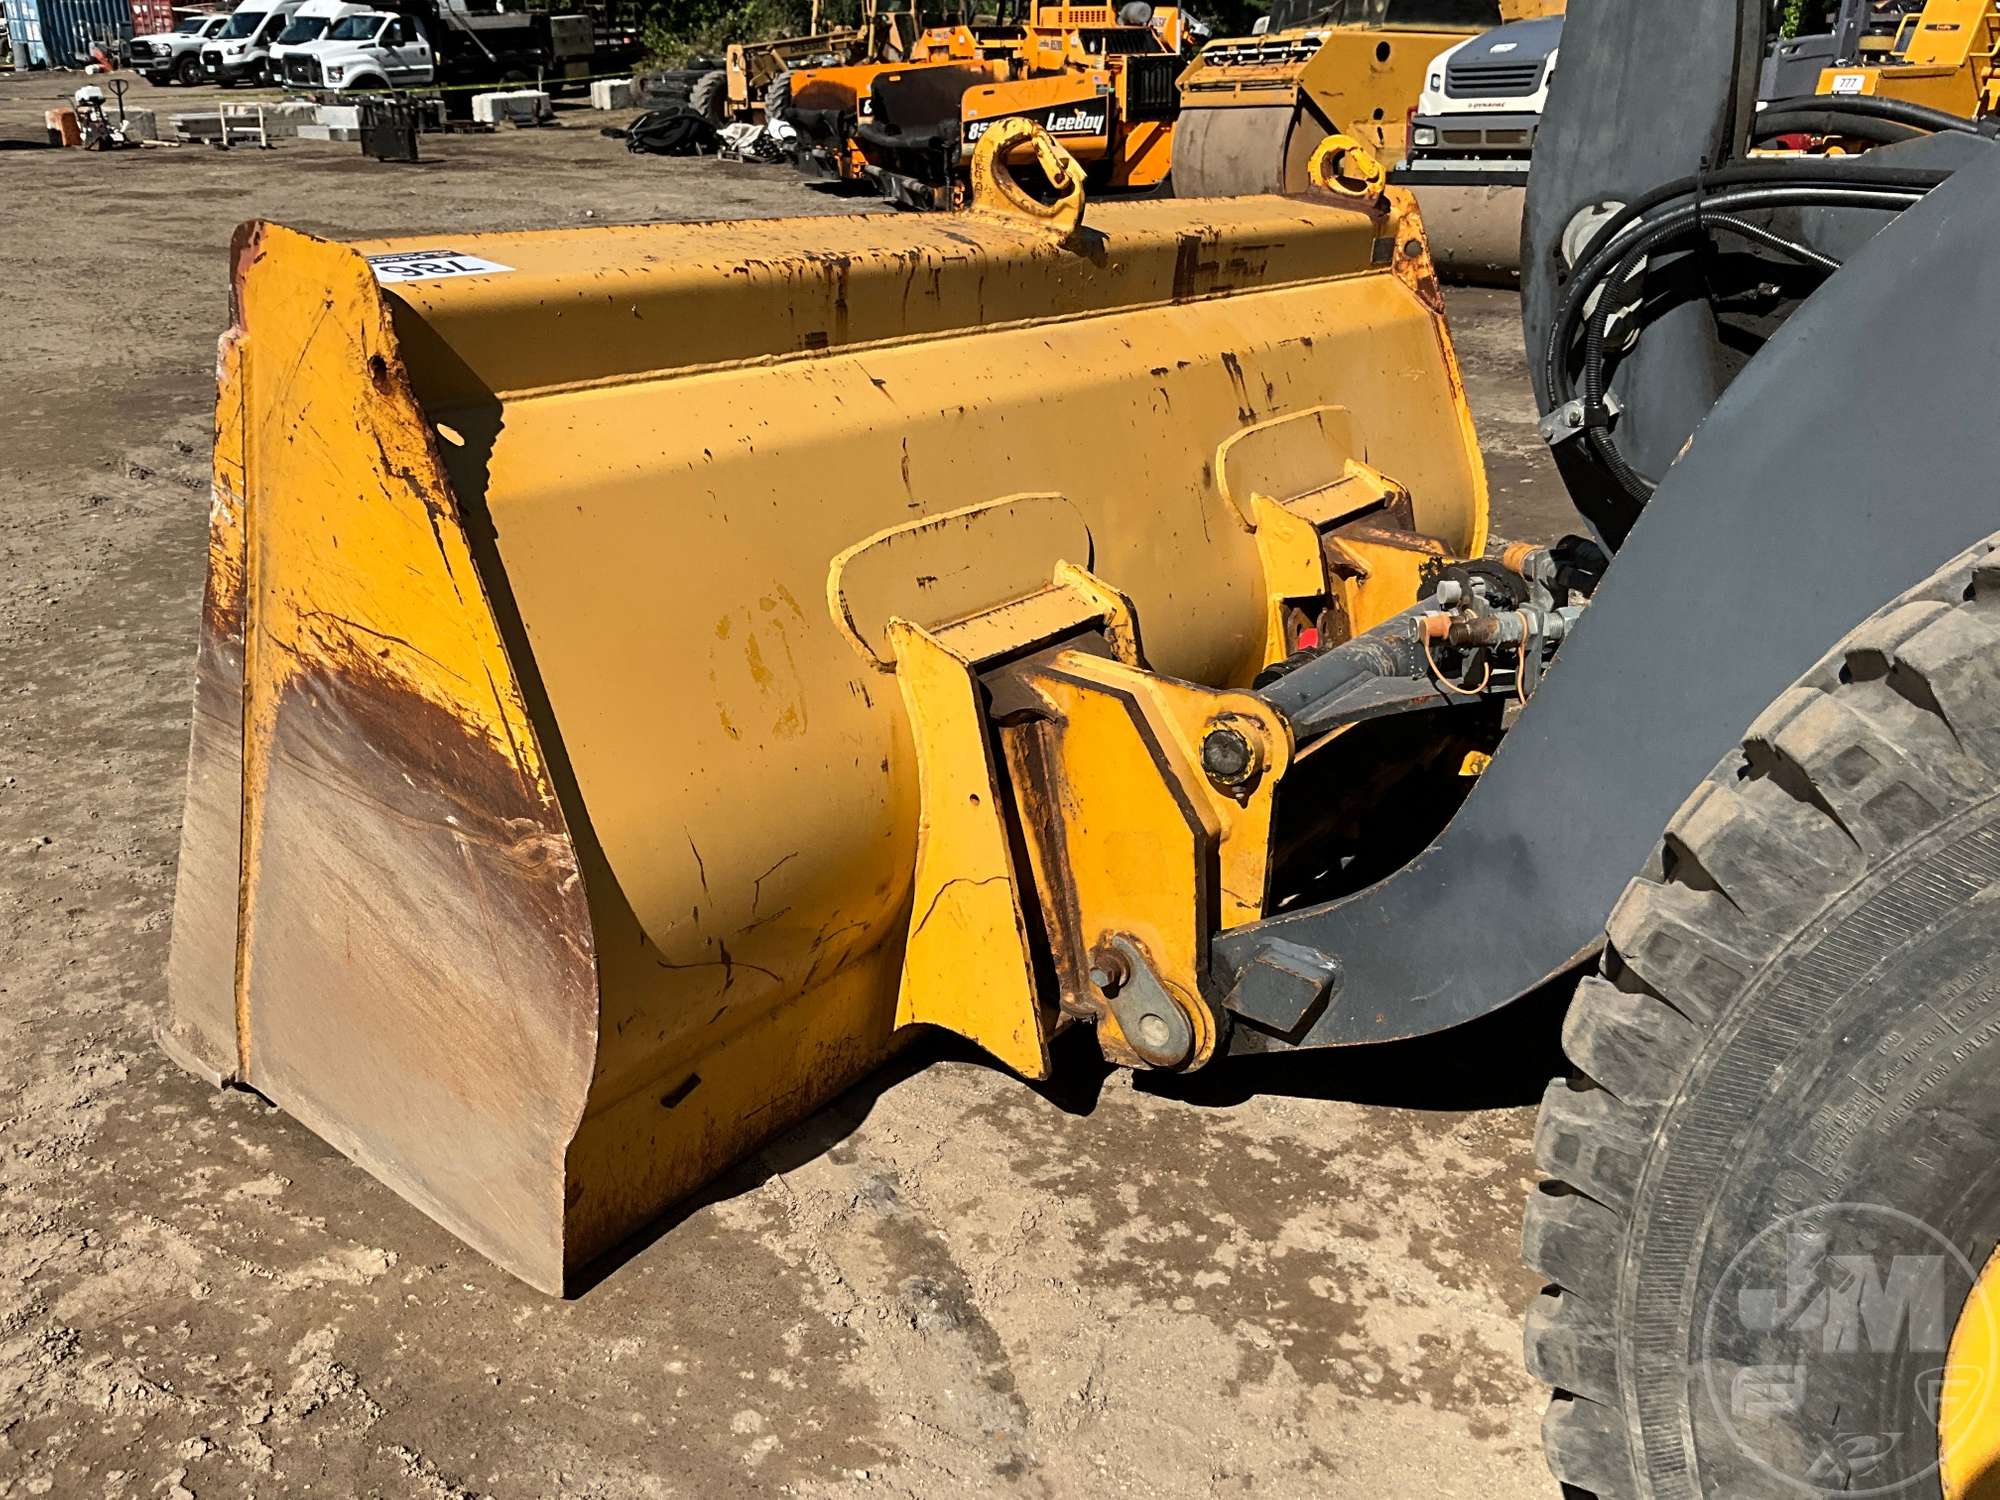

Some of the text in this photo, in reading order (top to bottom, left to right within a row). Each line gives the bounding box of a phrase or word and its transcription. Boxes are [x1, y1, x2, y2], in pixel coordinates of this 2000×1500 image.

[1840, 78, 1858, 88] 777
[1046, 110, 1105, 135] LeeBoy
[380, 260, 485, 277] 786
